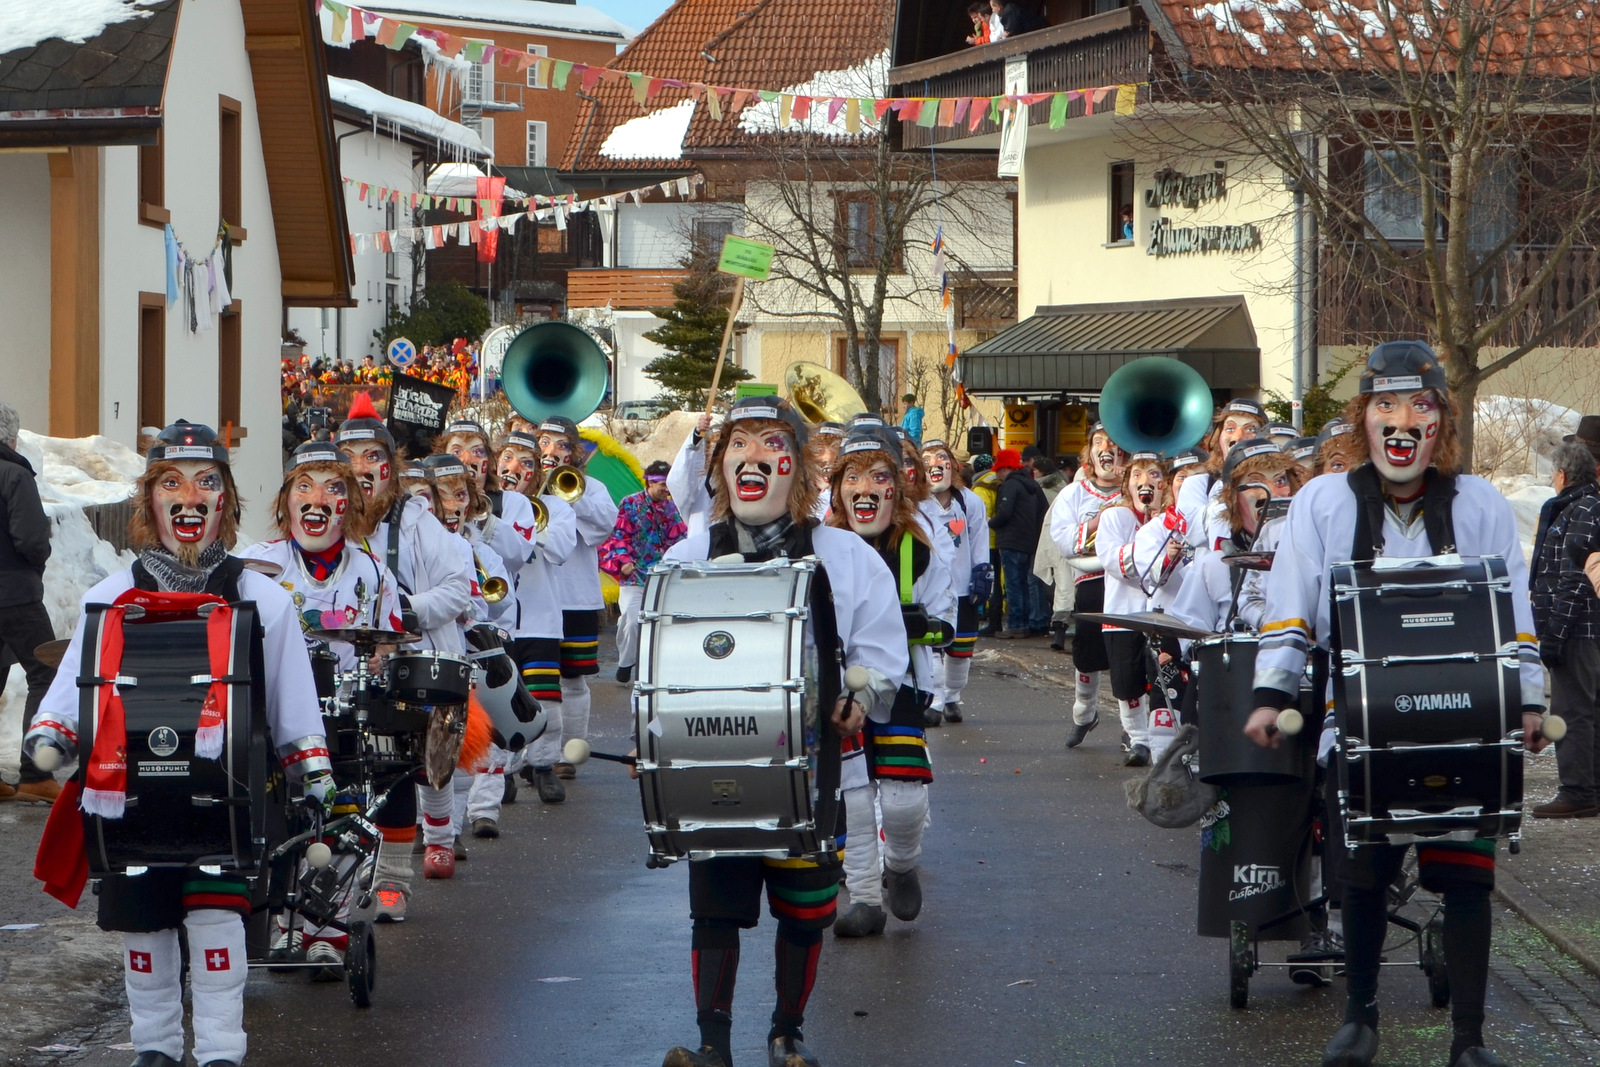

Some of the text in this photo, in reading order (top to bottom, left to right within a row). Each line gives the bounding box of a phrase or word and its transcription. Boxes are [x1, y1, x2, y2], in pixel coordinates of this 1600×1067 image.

[1413, 692, 1472, 711] YAMAHA
[684, 715, 758, 737] YAMAHA
[1233, 863, 1280, 884] Kirn
